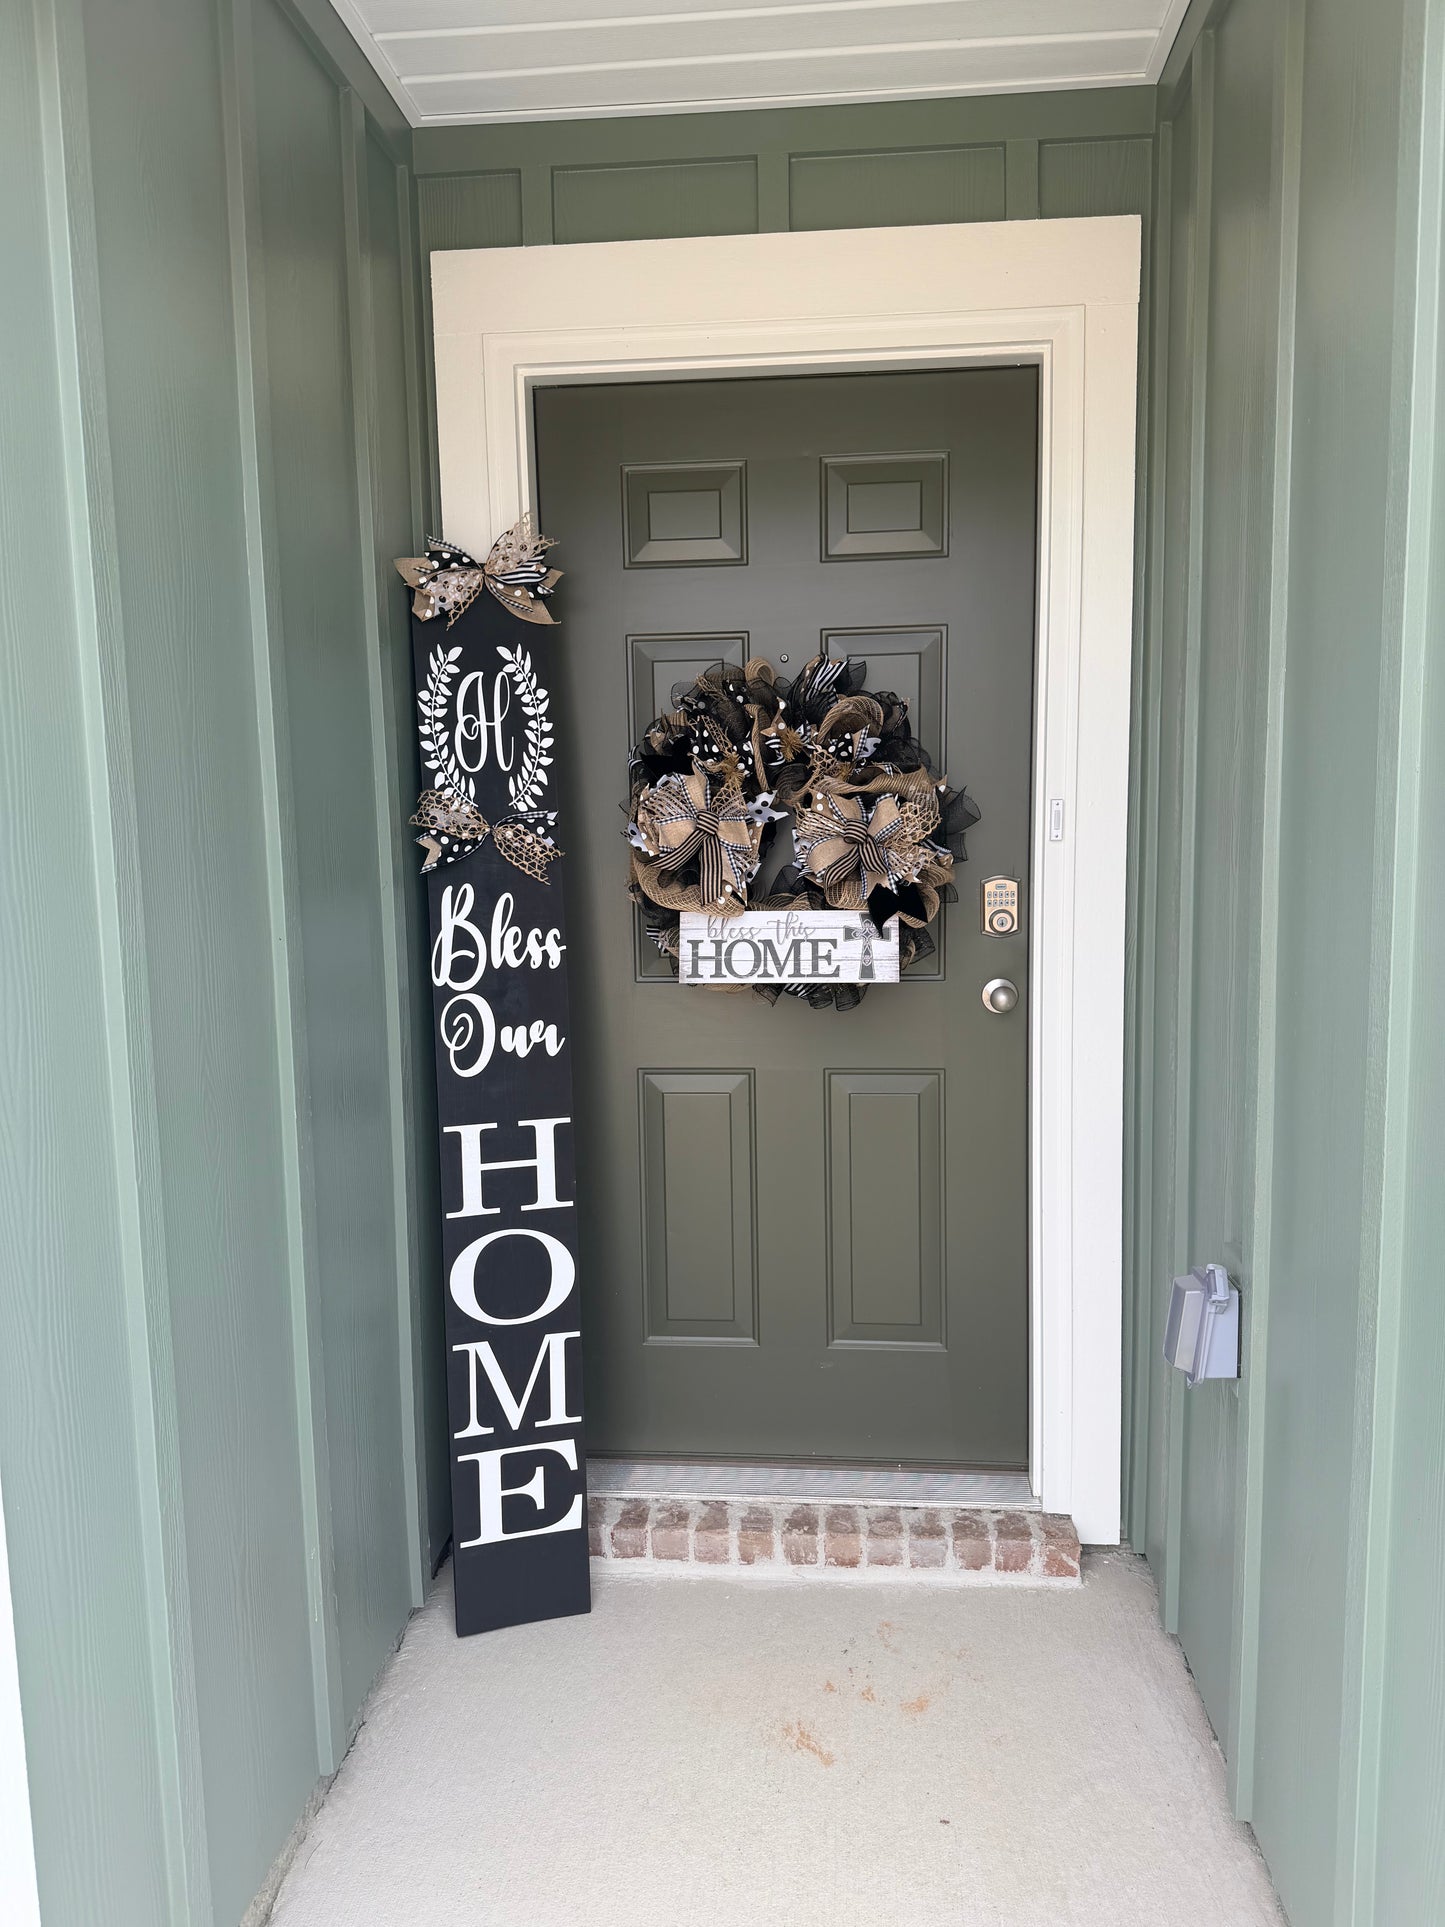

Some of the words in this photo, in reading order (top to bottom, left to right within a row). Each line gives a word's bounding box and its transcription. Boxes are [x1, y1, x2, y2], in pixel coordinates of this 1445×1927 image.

[432, 883, 567, 991] Bless
[686, 938, 840, 980] HOME
[707, 915, 761, 940] bless
[766, 911, 816, 945] this
[441, 993, 566, 1077] Our
[443, 1117, 582, 1548] HOME
